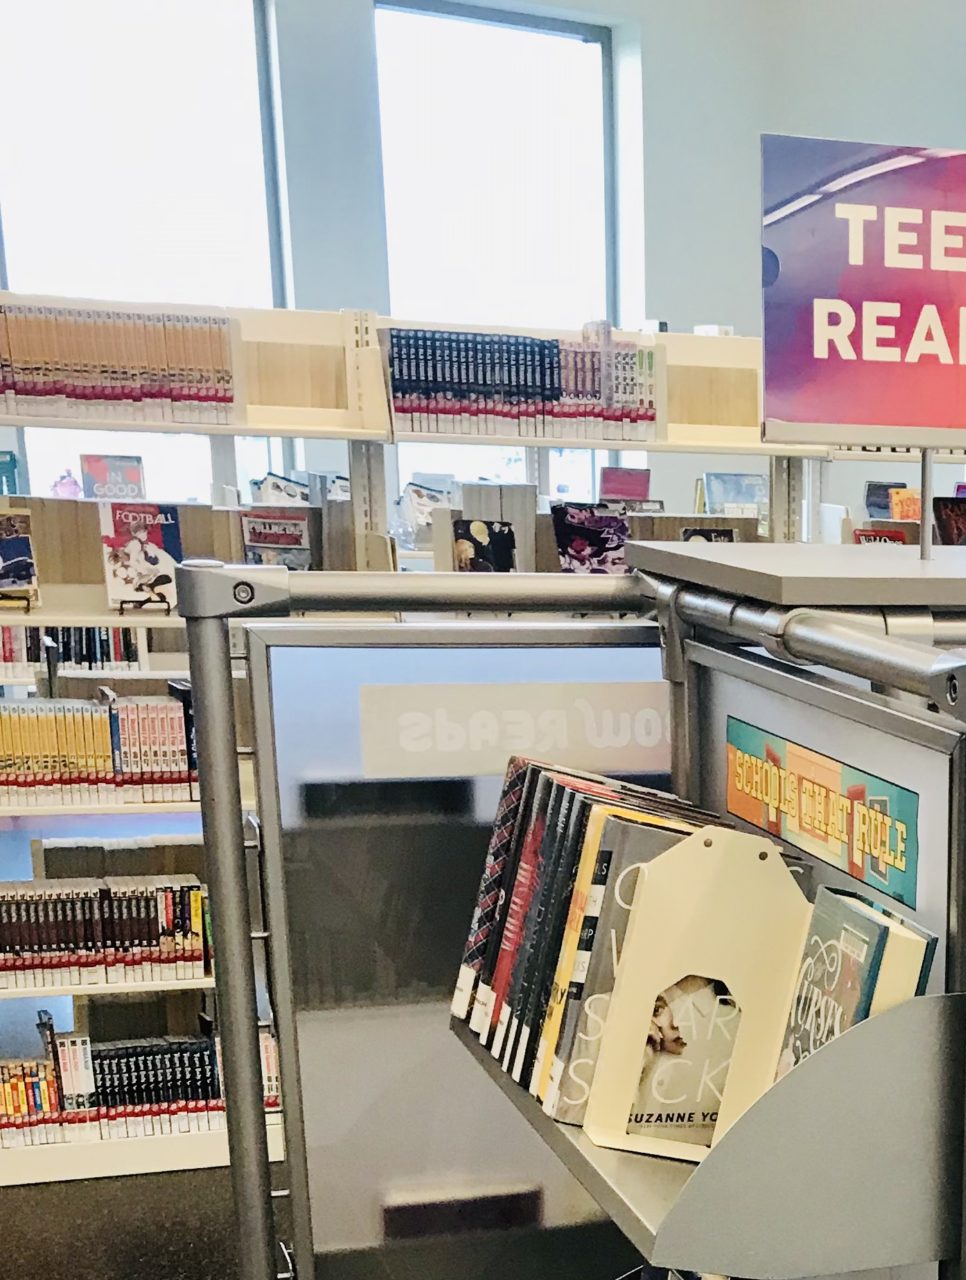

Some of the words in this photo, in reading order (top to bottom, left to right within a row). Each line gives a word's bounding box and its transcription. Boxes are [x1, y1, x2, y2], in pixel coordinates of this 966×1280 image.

[106, 471, 123, 483] IN
[93, 483, 139, 496] GOOD
[115, 509, 176, 525] FOOTBALL
[801, 777, 852, 844] THAT
[854, 801, 907, 872] RULE
[628, 1112, 695, 1124] SUZANNE
